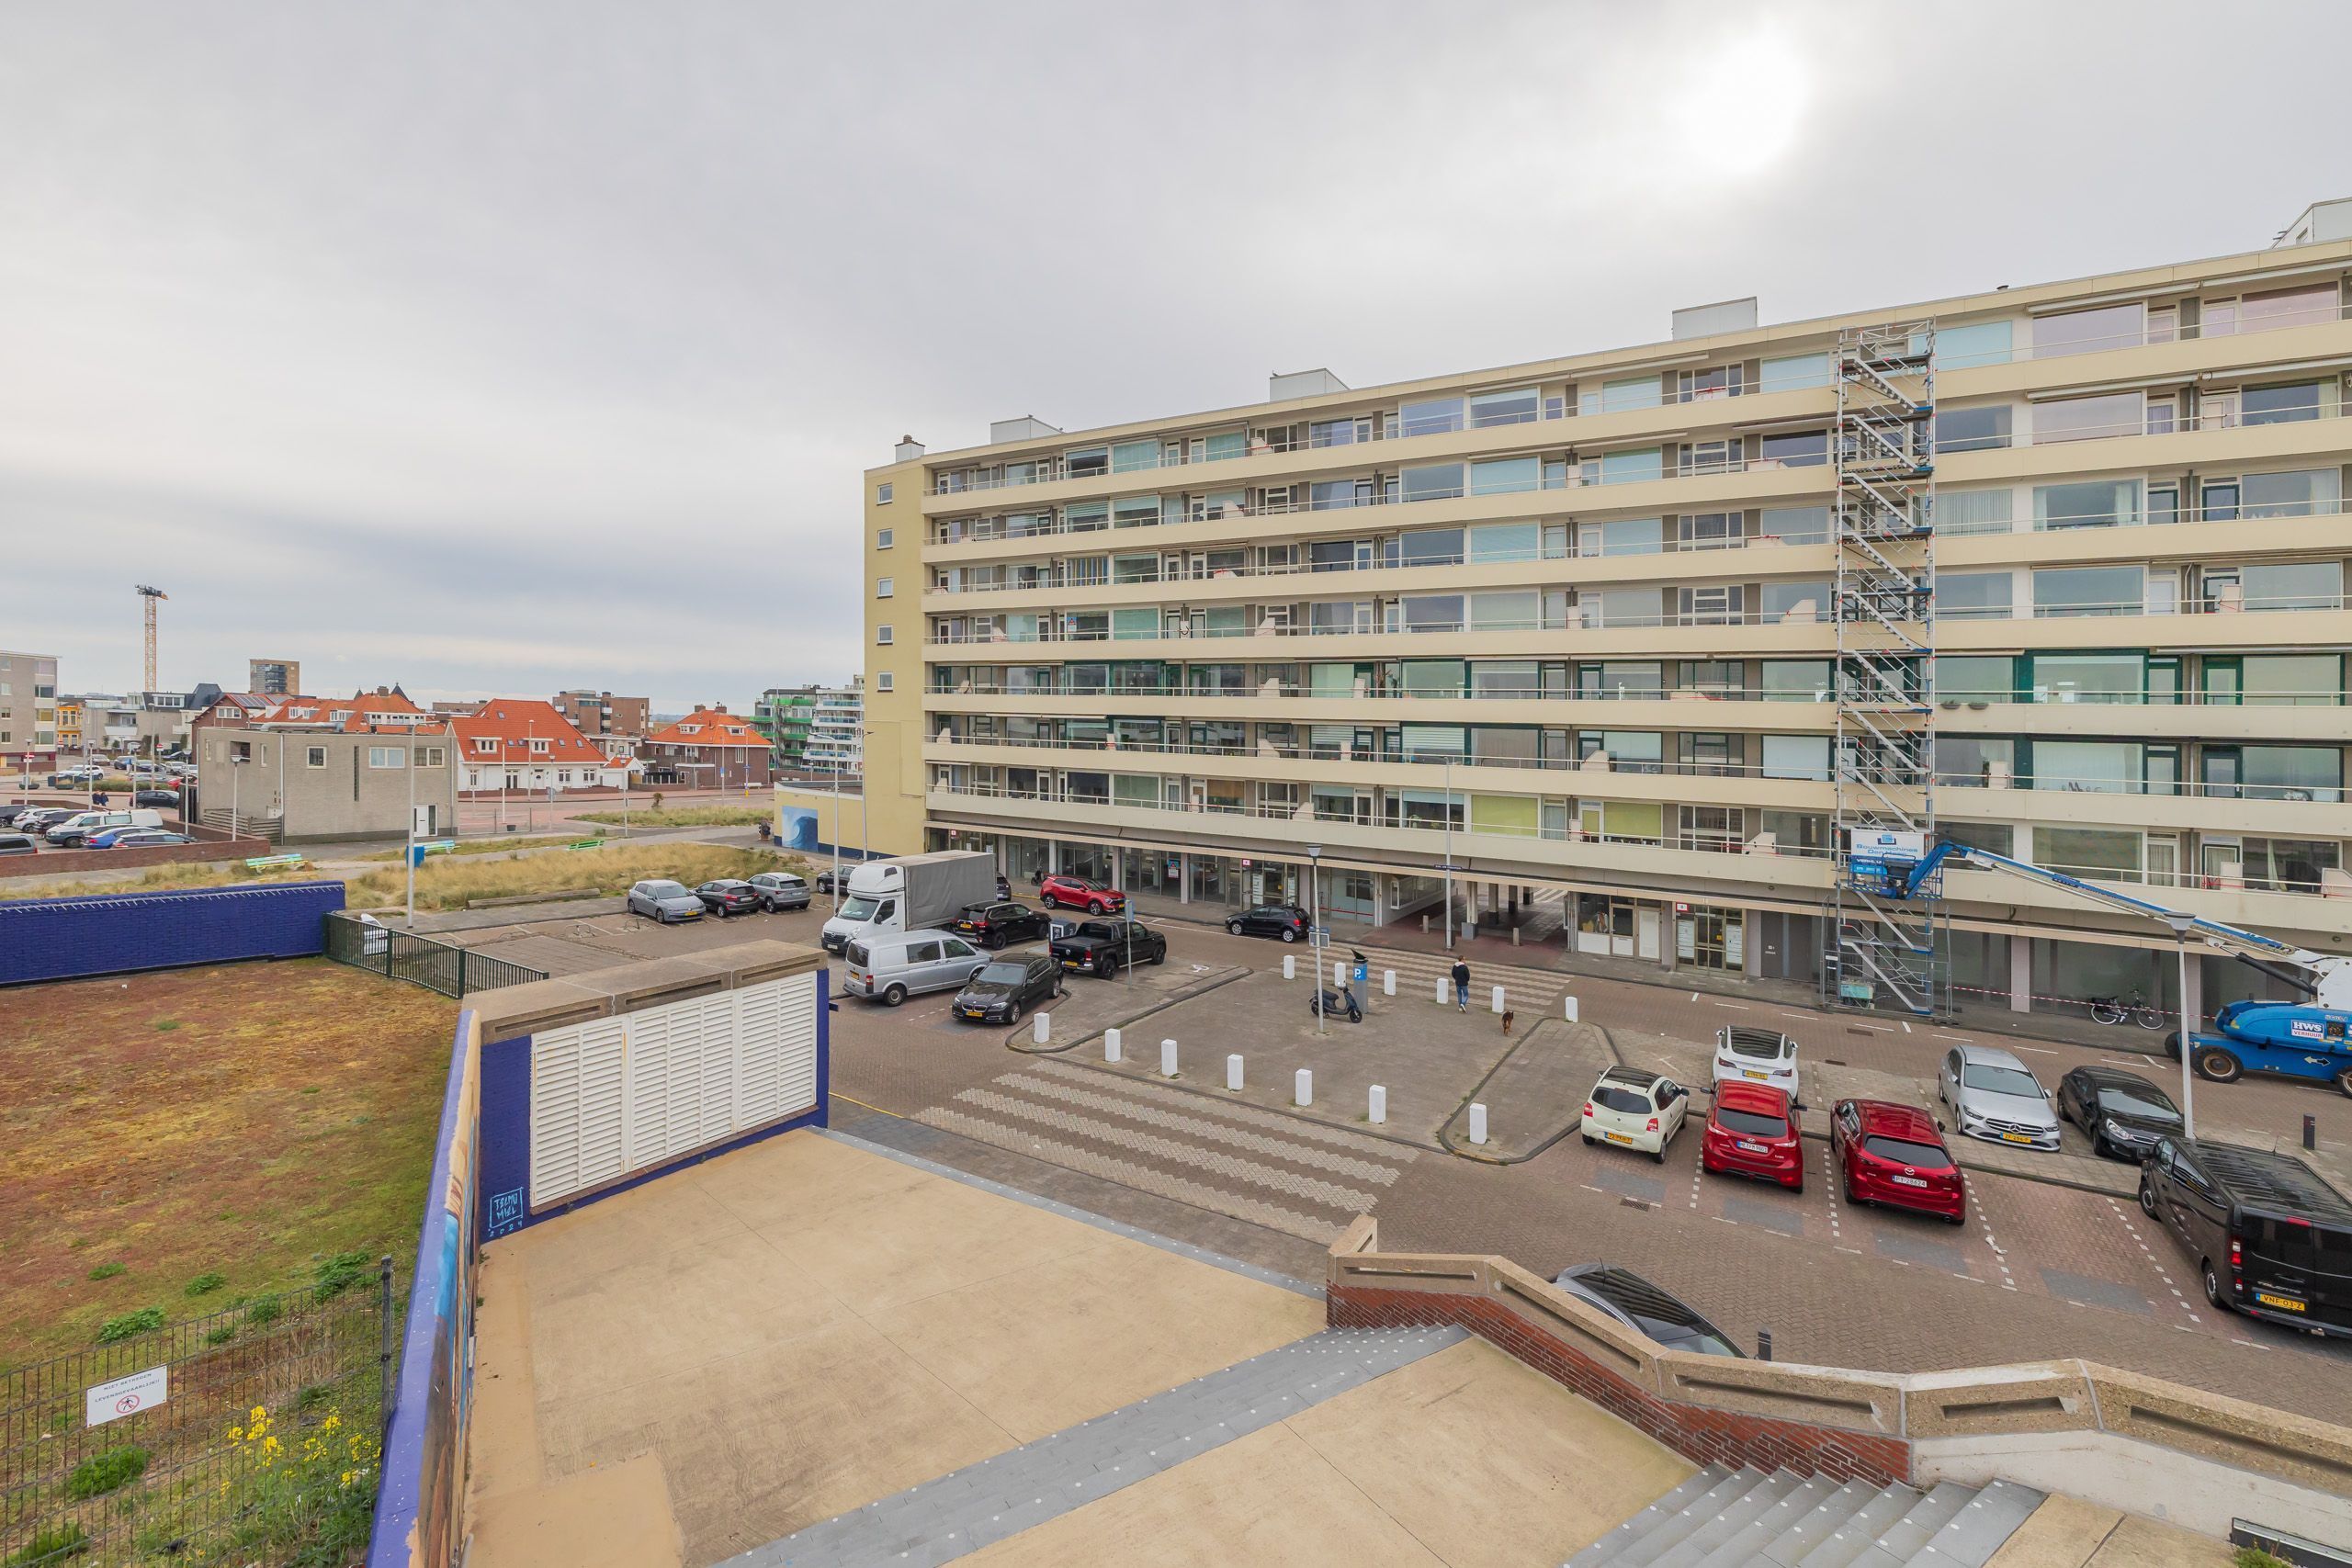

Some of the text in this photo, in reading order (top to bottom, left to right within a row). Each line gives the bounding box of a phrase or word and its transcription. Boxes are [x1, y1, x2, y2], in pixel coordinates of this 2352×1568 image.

[2292, 1021, 2323, 1032] HWS
[2293, 1030, 2323, 1038] VERHUUR
[2263, 1294, 2301, 1310] VNF-03-Z
[120, 1373, 153, 1386] BETREDEN
